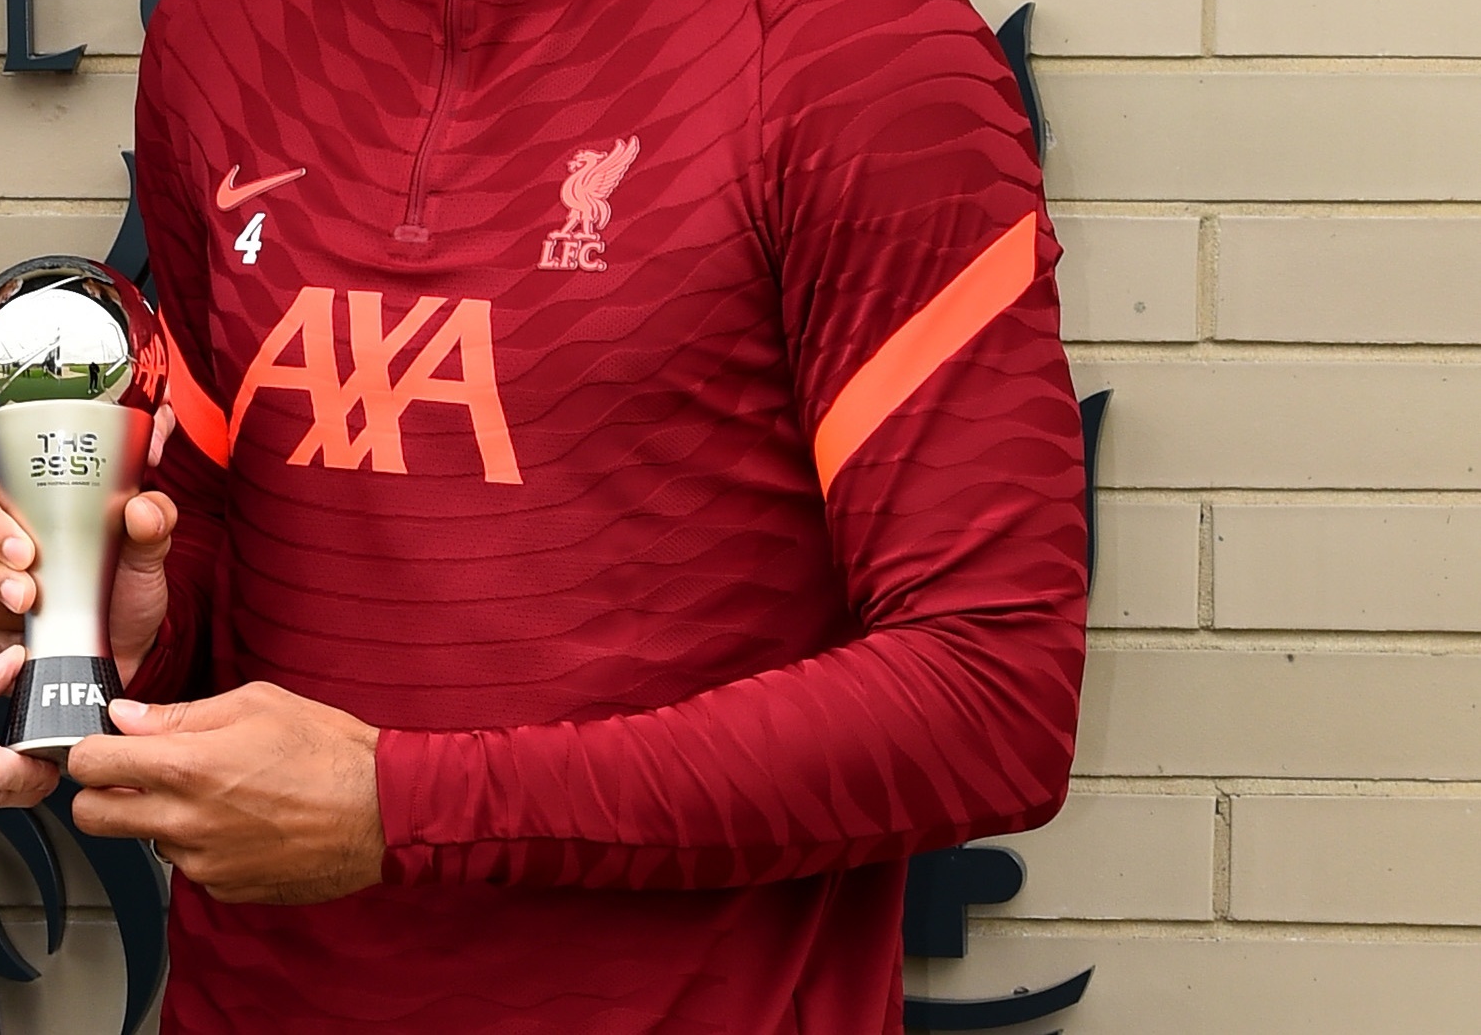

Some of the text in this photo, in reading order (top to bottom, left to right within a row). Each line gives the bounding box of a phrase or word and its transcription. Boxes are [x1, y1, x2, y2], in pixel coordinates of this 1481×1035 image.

[233, 212, 266, 265] 4
[537, 239, 608, 273] L.F.C.
[228, 285, 524, 486] AXA
[40, 682, 107, 708] FIFA
